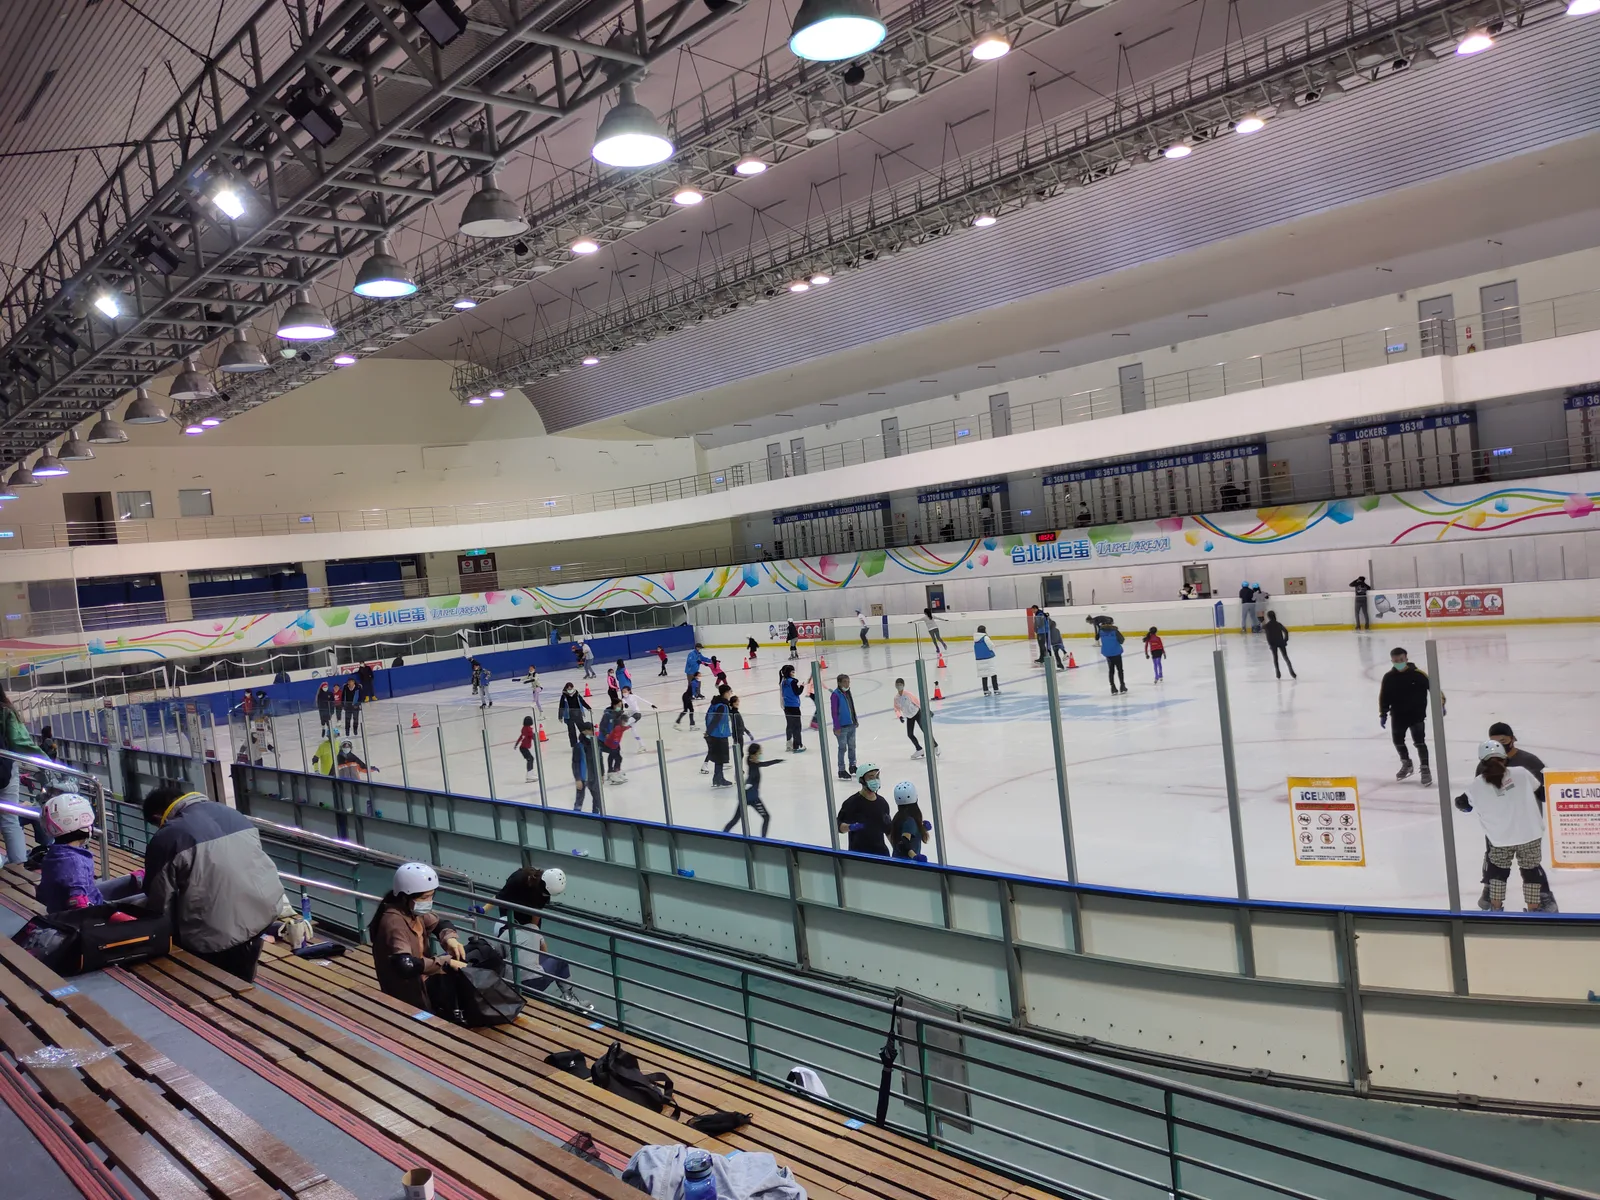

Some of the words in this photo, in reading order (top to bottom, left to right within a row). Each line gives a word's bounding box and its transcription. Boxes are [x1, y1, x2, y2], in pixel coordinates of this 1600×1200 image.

[1355, 426, 1388, 439] LOCKERS
[1011, 540, 1090, 564] 台北小巨蛋
[1096, 541, 1131, 555] TAIPEI
[1132, 538, 1169, 552] ARENA
[354, 607, 425, 628] 台北小巨蛋
